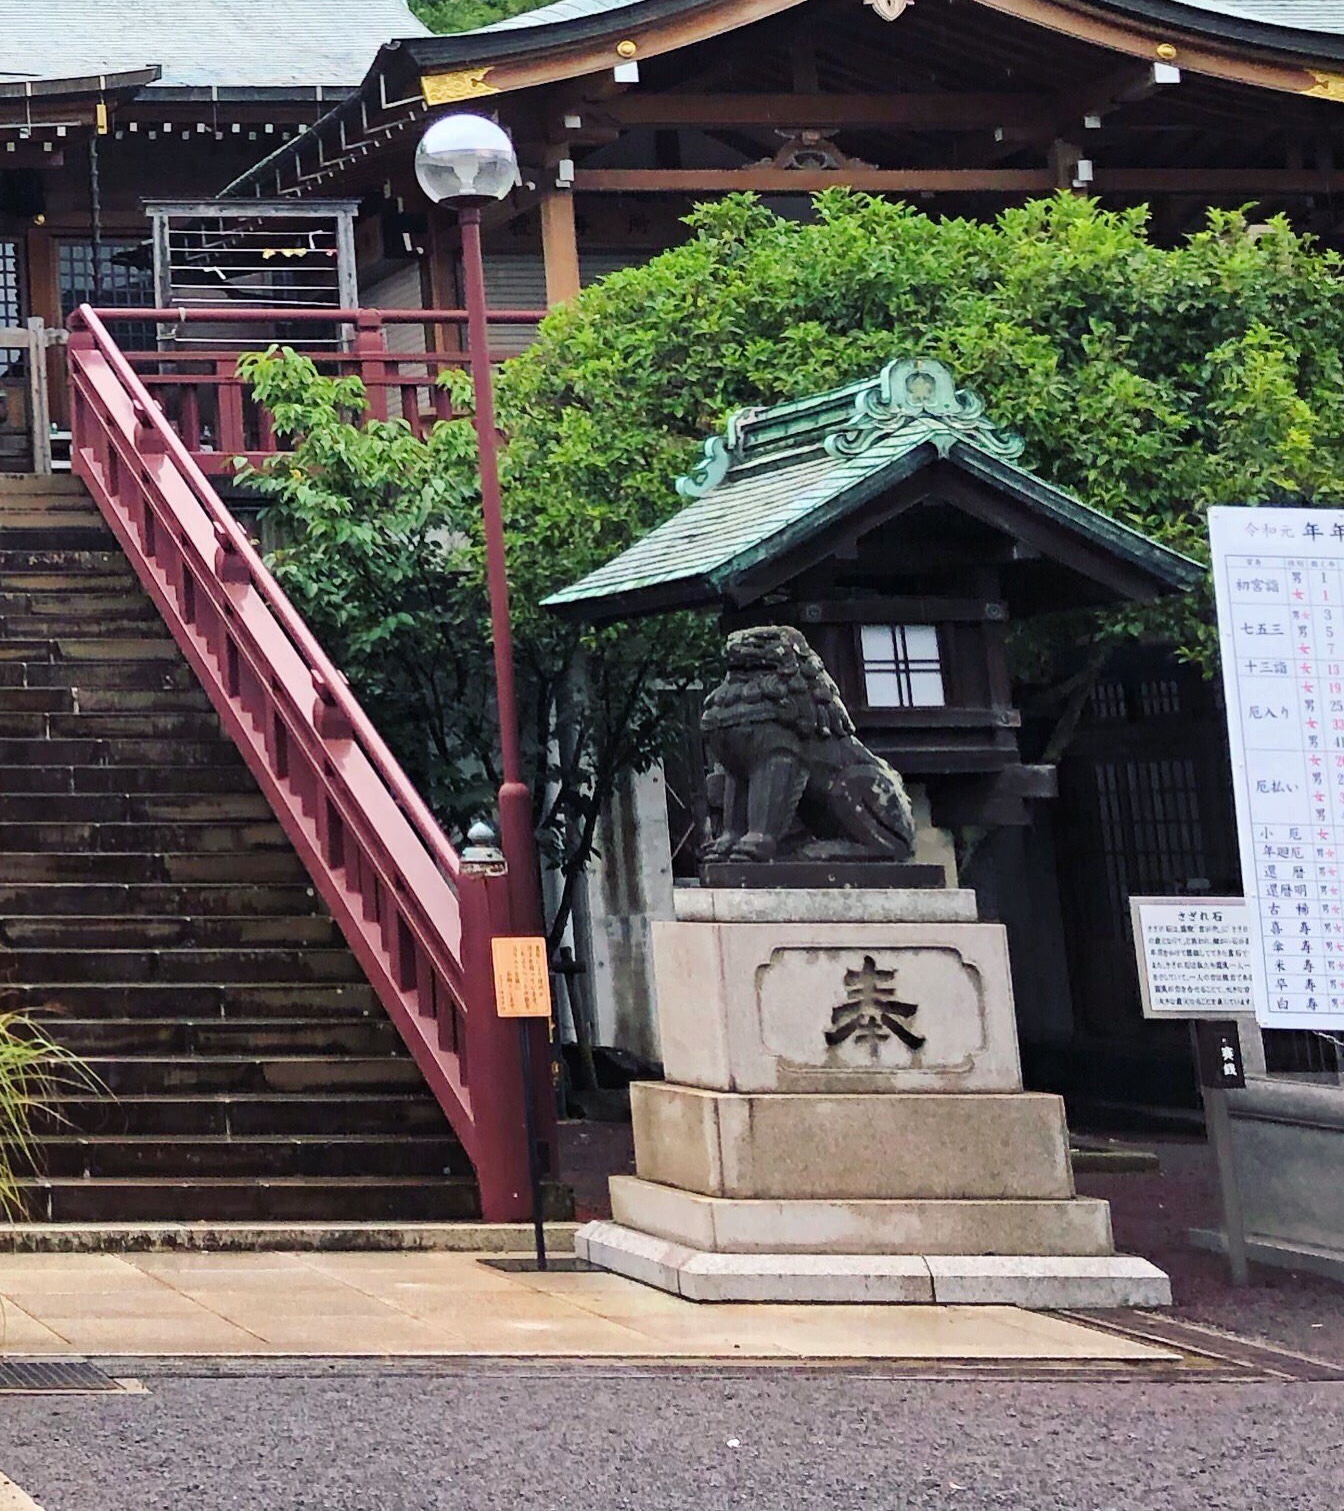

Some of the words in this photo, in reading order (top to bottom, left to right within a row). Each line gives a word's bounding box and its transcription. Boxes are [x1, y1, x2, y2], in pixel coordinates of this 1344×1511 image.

[1292, 572, 1302, 583] 男
[1321, 572, 1328, 583] 1
[1236, 578, 1279, 593] 初宮詣
[1292, 588, 1305, 600] 女
[1323, 590, 1329, 601] 1
[1324, 608, 1332, 621] 3
[1240, 622, 1284, 636] 七五三
[1297, 626, 1308, 638] 男
[1326, 626, 1334, 638] 5
[1299, 643, 1310, 655] 女
[1327, 643, 1335, 655] 7
[1245, 660, 1288, 674] 十三詣
[1300, 663, 1312, 674] 女
[1328, 664, 1340, 675] 13
[1301, 681, 1313, 693] 女
[1329, 682, 1341, 694] 19
[1304, 699, 1314, 712] 男
[1330, 700, 1343, 713] 25
[1249, 705, 1289, 719] 厄入り
[1306, 717, 1318, 729] 女
[1308, 735, 1318, 748] 男
[1309, 754, 1321, 766] 女
[1312, 772, 1322, 785] 男
[1257, 779, 1299, 793] 厄払い
[1313, 790, 1326, 802] 女
[1316, 808, 1325, 821] 男
[1317, 828, 1329, 840] 女
[1178, 911, 1223, 922] さざれ石
[823, 955, 927, 1058] 奉
